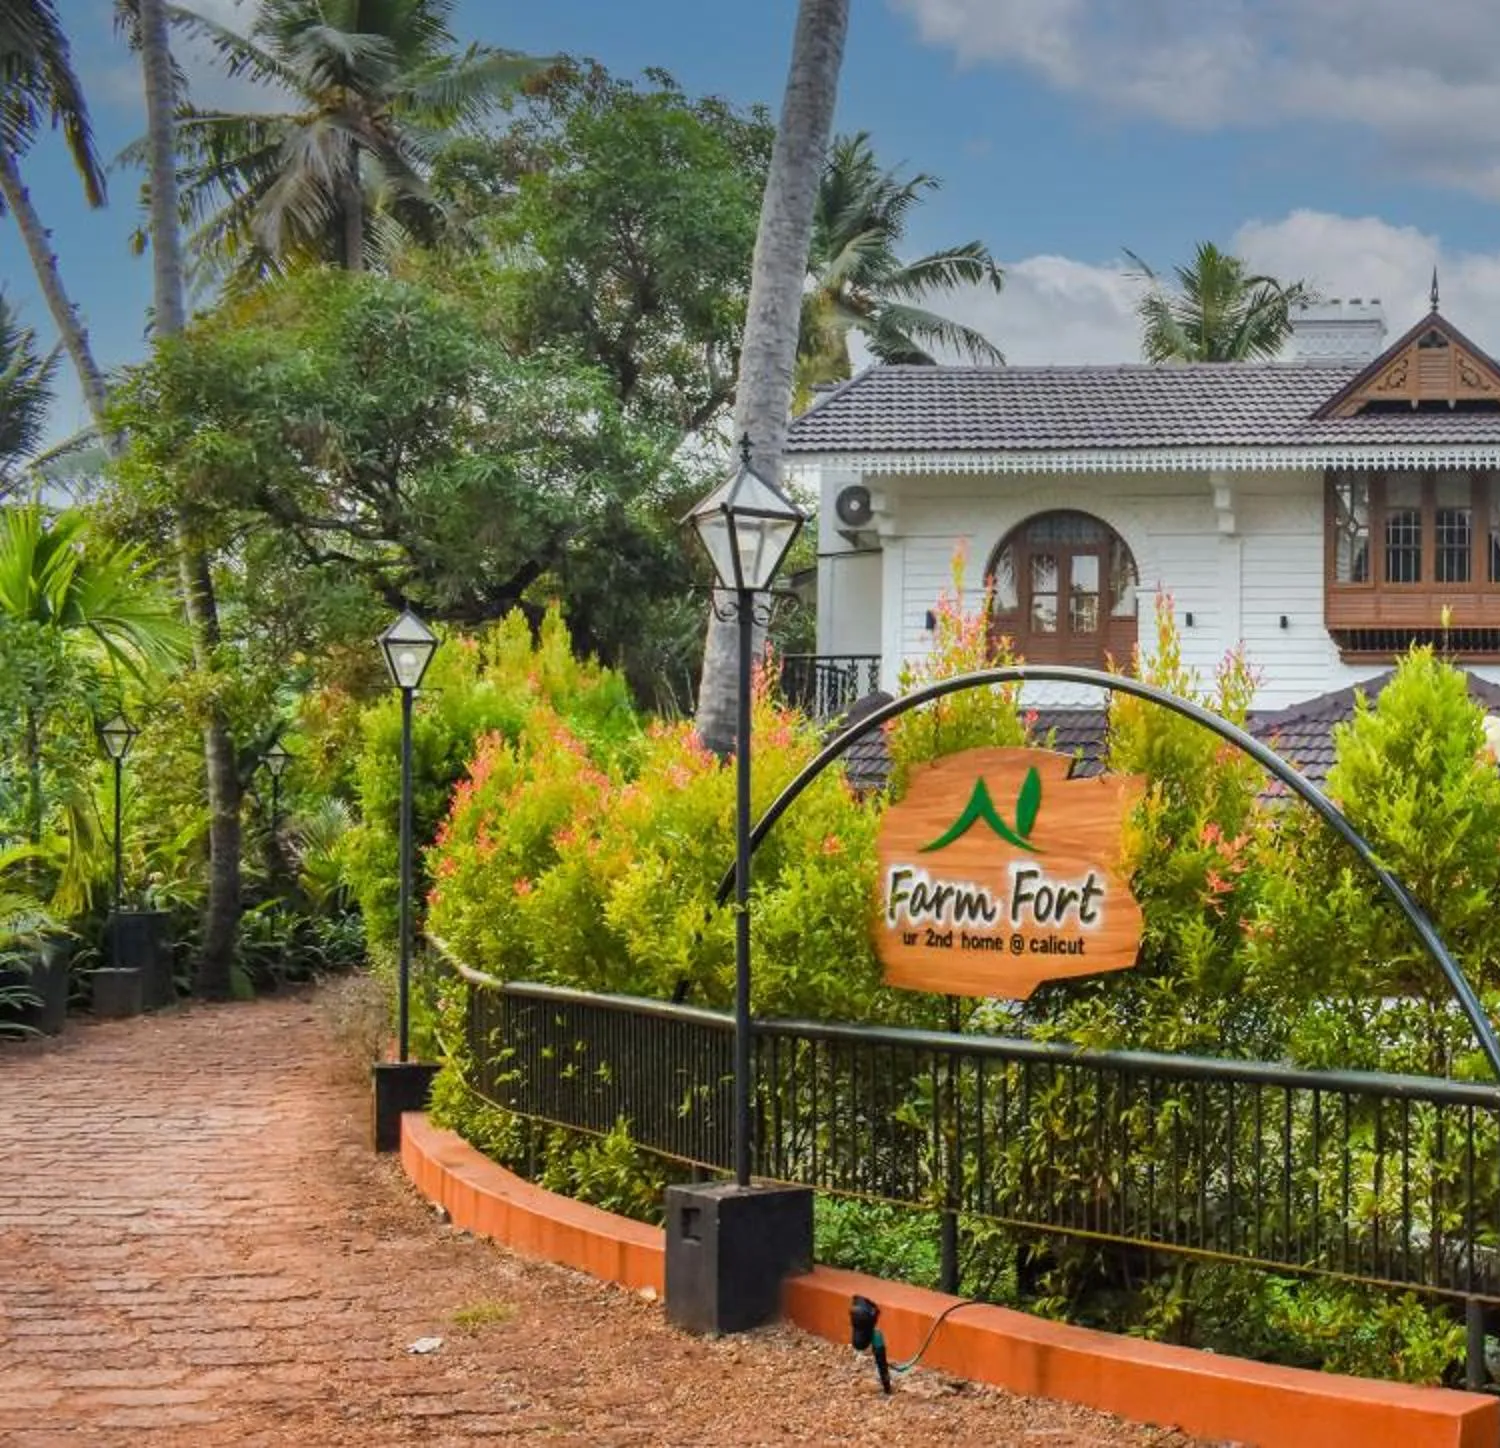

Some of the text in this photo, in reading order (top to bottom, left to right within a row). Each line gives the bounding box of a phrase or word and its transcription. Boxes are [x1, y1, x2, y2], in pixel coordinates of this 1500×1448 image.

[888, 869, 1104, 923] Farm Fort
[903, 928, 1085, 955] ur 2nd home @ calicut
